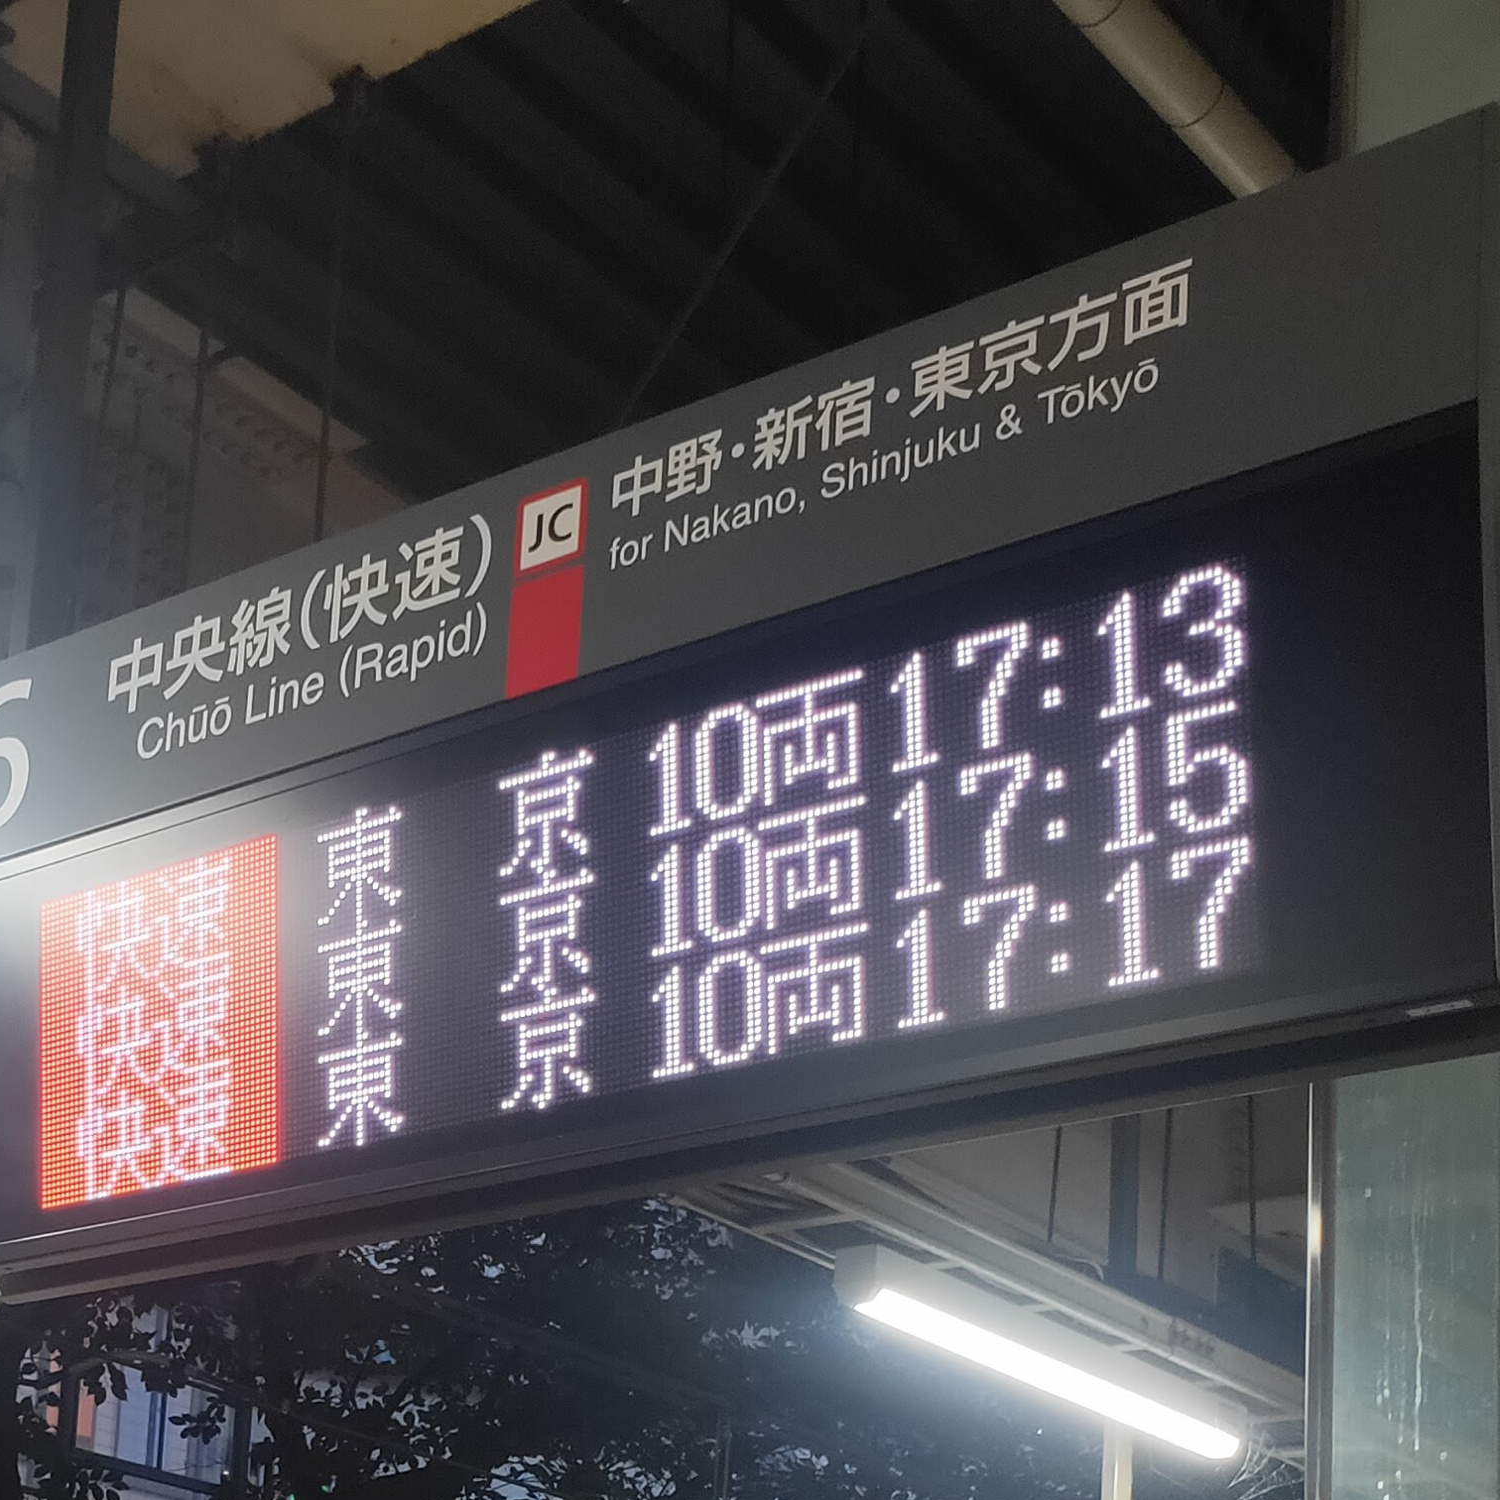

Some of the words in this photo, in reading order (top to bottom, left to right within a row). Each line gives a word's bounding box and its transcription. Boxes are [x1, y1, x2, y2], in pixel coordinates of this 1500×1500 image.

[608, 531, 653, 571] for
[663, 485, 808, 552] Nakano,
[819, 424, 983, 499] Shinjuku
[994, 402, 1023, 441] &
[1036, 357, 1160, 426] Tōkyō
[610, 257, 1194, 519] 中野・新宿・東京方面
[106, 515, 494, 714] 中央線(快速)
[527, 502, 575, 552] JC
[136, 699, 233, 760] Chūō
[244, 668, 325, 727] Line
[338, 601, 488, 699] (Rapid)
[649, 667, 865, 838] 10両
[889, 563, 1247, 775] 17:13
[650, 795, 869, 957] 10両
[893, 700, 1252, 902] 17:15
[652, 921, 871, 1080] 10両
[896, 836, 1253, 1030] 17:17
